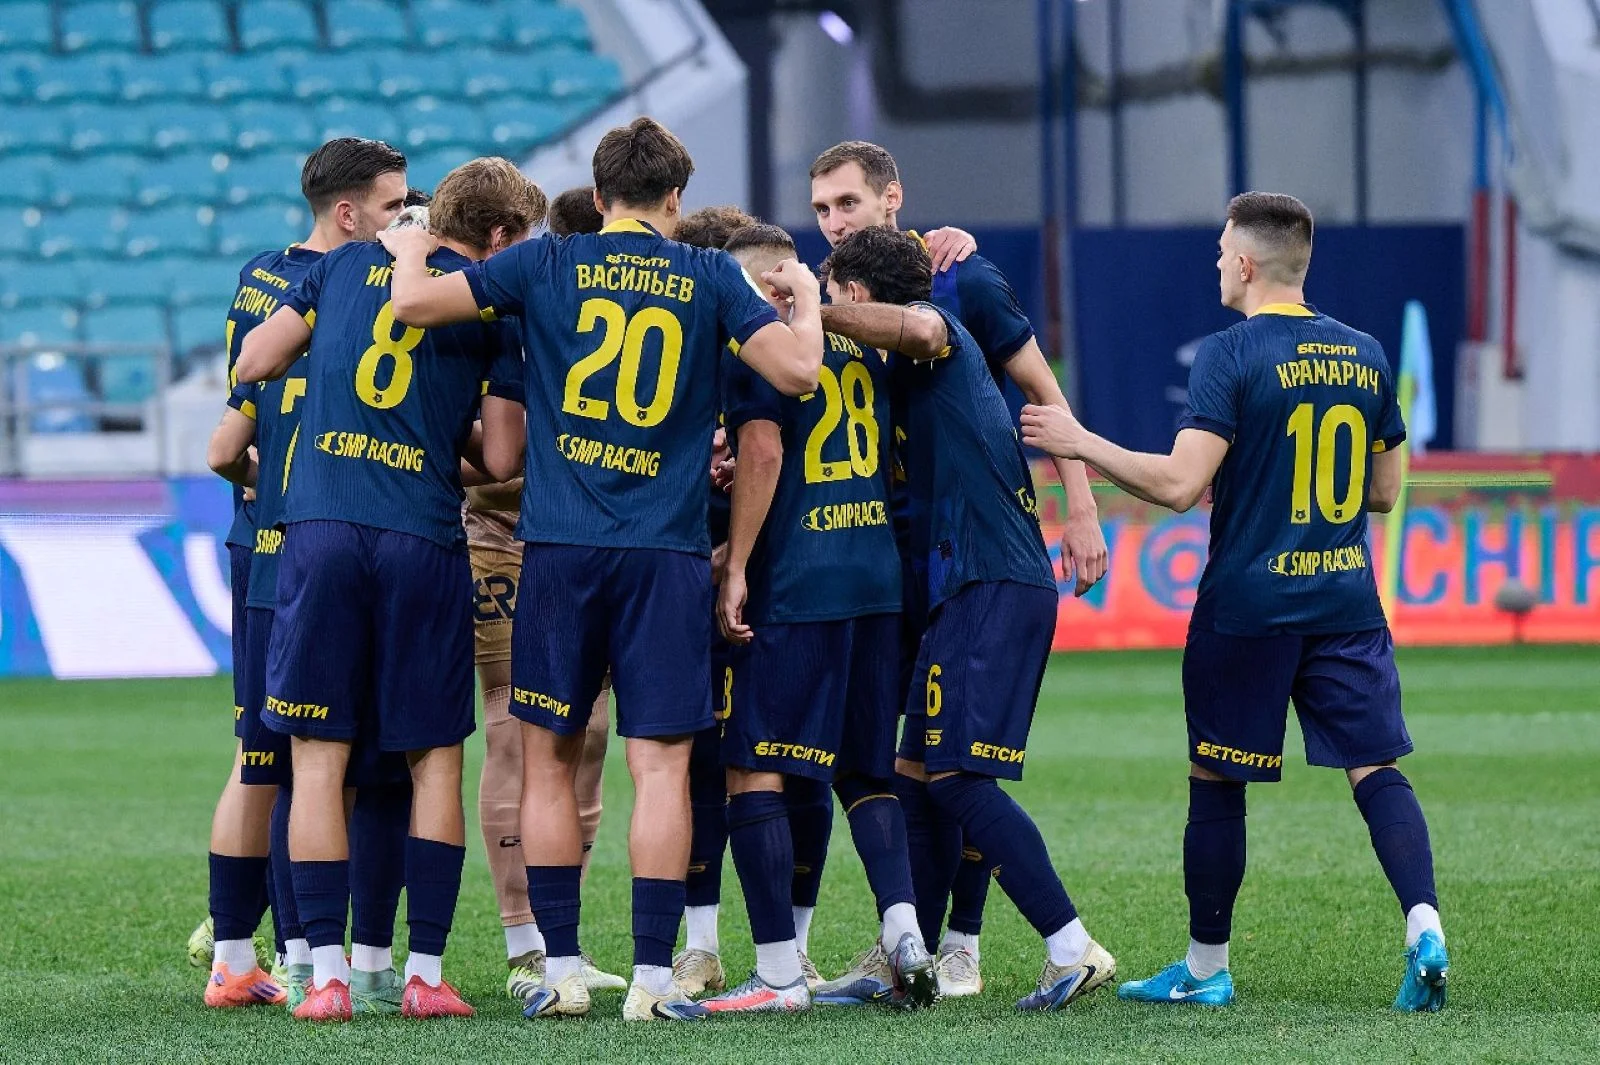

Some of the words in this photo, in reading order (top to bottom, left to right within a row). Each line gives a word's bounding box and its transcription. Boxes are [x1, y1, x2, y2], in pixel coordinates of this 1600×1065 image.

[576, 264, 695, 303] ВАСИЛЬЕВ
[355, 299, 426, 409] 8
[562, 298, 683, 427] 20
[1297, 343, 1357, 356] БЕТСИТИ
[1276, 359, 1380, 395] КРАМАРИЧ
[800, 360, 879, 484] 28
[334, 431, 368, 458] SMP
[366, 437, 425, 472] RACING
[566, 436, 603, 466] SMP
[600, 443, 661, 477] RACING
[1286, 402, 1367, 524] 10
[1289, 551, 1321, 576] SMP
[266, 695, 329, 720] ЕТСИТИ
[754, 741, 836, 767] БЕТСИТИ
[970, 741, 1026, 763] БЕТСИ
[1196, 741, 1282, 768] БЕТСИТИ
